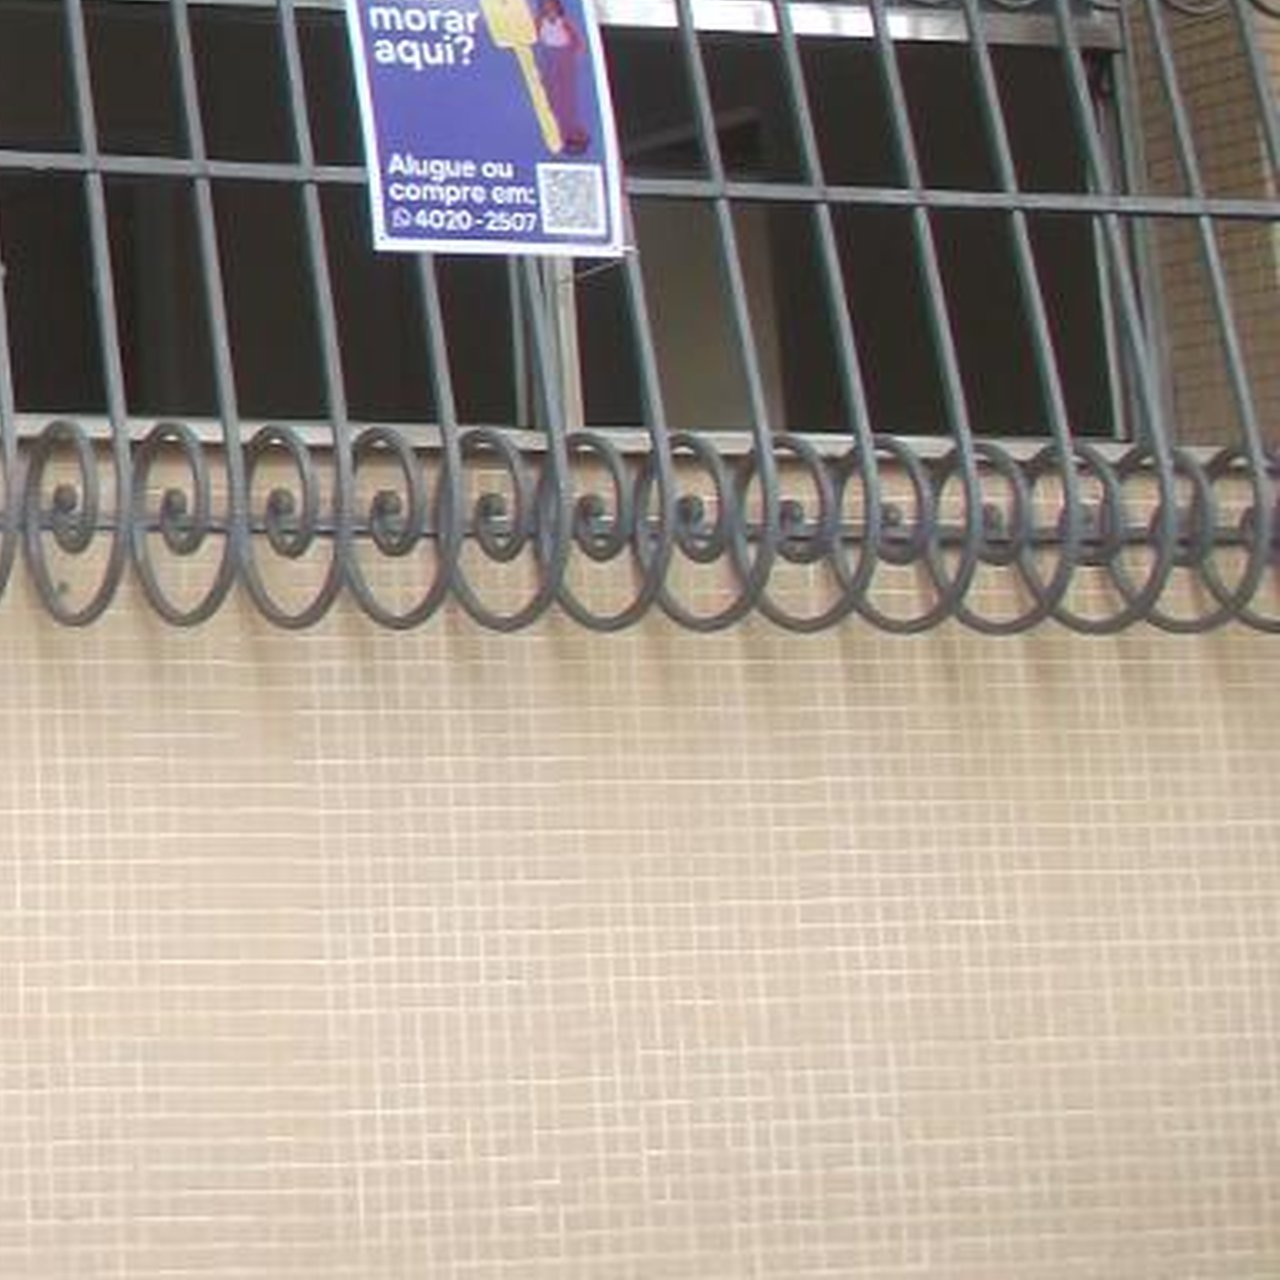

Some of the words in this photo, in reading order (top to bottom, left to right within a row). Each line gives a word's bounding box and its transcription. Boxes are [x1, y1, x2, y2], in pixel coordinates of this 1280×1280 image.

[369, 5, 479, 33] morar
[374, 35, 474, 70] aqui?
[389, 153, 477, 183] Alugue
[481, 160, 514, 179] ou
[389, 182, 486, 206] compre
[491, 185, 537, 205] em:
[415, 208, 538, 232] 4020-2507
